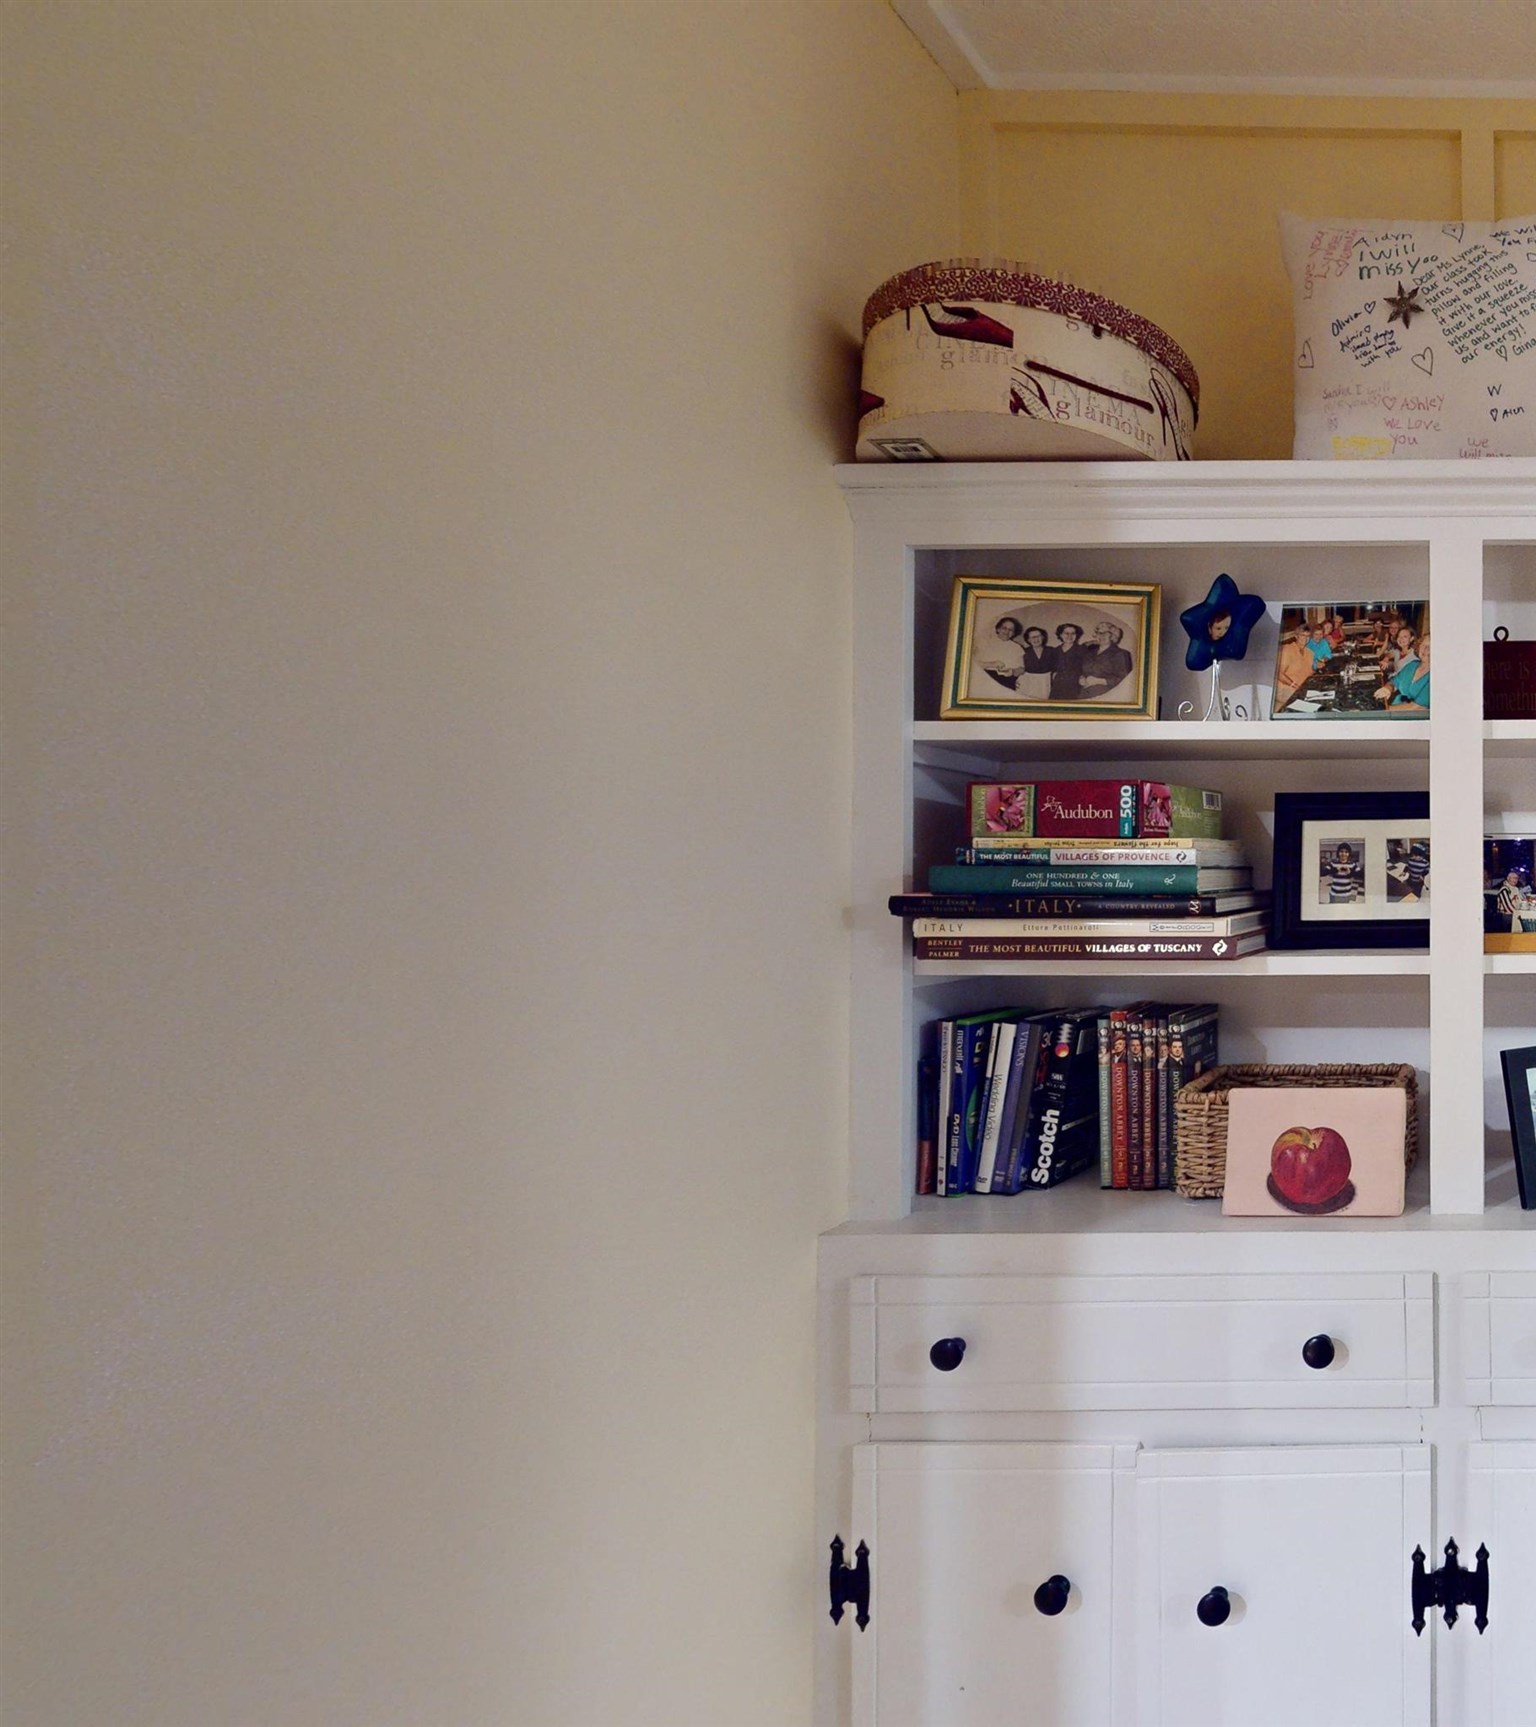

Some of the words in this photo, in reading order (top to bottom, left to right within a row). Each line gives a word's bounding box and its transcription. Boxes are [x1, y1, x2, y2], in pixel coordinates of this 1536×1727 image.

[1413, 270, 1436, 287] Dear
[1443, 264, 1468, 283] class
[1467, 250, 1493, 268] took
[1425, 287, 1454, 307] turns
[1454, 261, 1491, 288] hugging
[1431, 296, 1462, 317] pillow
[1462, 282, 1483, 297] and
[1484, 263, 1518, 283] filling
[1442, 319, 1467, 337] Give
[1489, 283, 1528, 309] squeeze
[1449, 303, 1474, 321] with
[1474, 292, 1492, 305] our
[1500, 302, 1520, 318] you
[1331, 311, 1362, 337] Olivia
[1471, 331, 1491, 347] and
[1492, 315, 1519, 335] want
[1518, 308, 1531, 318] to
[1460, 349, 1479, 364] our
[1484, 323, 1528, 351] energy!
[1055, 398, 1156, 447] glamour
[1053, 803, 1113, 820] Audubon
[1120, 785, 1132, 818] 500
[980, 853, 992, 861] THE
[994, 853, 1012, 861] MOST
[1013, 853, 1049, 861] BEAUTIFUL
[1055, 852, 1099, 862] VILLAGES
[1102, 852, 1115, 862] OF
[1118, 852, 1170, 862] PROVENCE
[1011, 879, 1049, 888] Beautiful
[1105, 880, 1114, 888] in
[1115, 879, 1134, 890] Italy
[1026, 872, 1044, 880] ONE
[1046, 872, 1088, 880] HUNDRED
[1090, 871, 1101, 880] &
[1102, 872, 1120, 880] ONE
[1015, 899, 1078, 914] ITALY
[924, 923, 964, 933] ITALY
[1022, 924, 1049, 932] Ettore
[968, 945, 990, 953] THE
[992, 945, 1021, 953] MOST
[1024, 944, 1082, 953] BEAUTIFUL
[1085, 944, 1136, 953] VILLAGES
[1138, 944, 1151, 953] OF
[1153, 943, 1203, 953] TUSCANY
[955, 1030, 965, 1060] maxell
[1014, 1030, 1030, 1067] VISIONS
[987, 1074, 1004, 1113] Wedding
[1115, 1066, 1123, 1111] DOWNTON
[1131, 1069, 1139, 1114] DOWNTON
[952, 1114, 960, 1135] DVD
[984, 1115, 996, 1141] Video
[1115, 1113, 1123, 1142] ABBEY
[1131, 1116, 1139, 1144] ABBEY
[1030, 1108, 1060, 1184] Scotch
